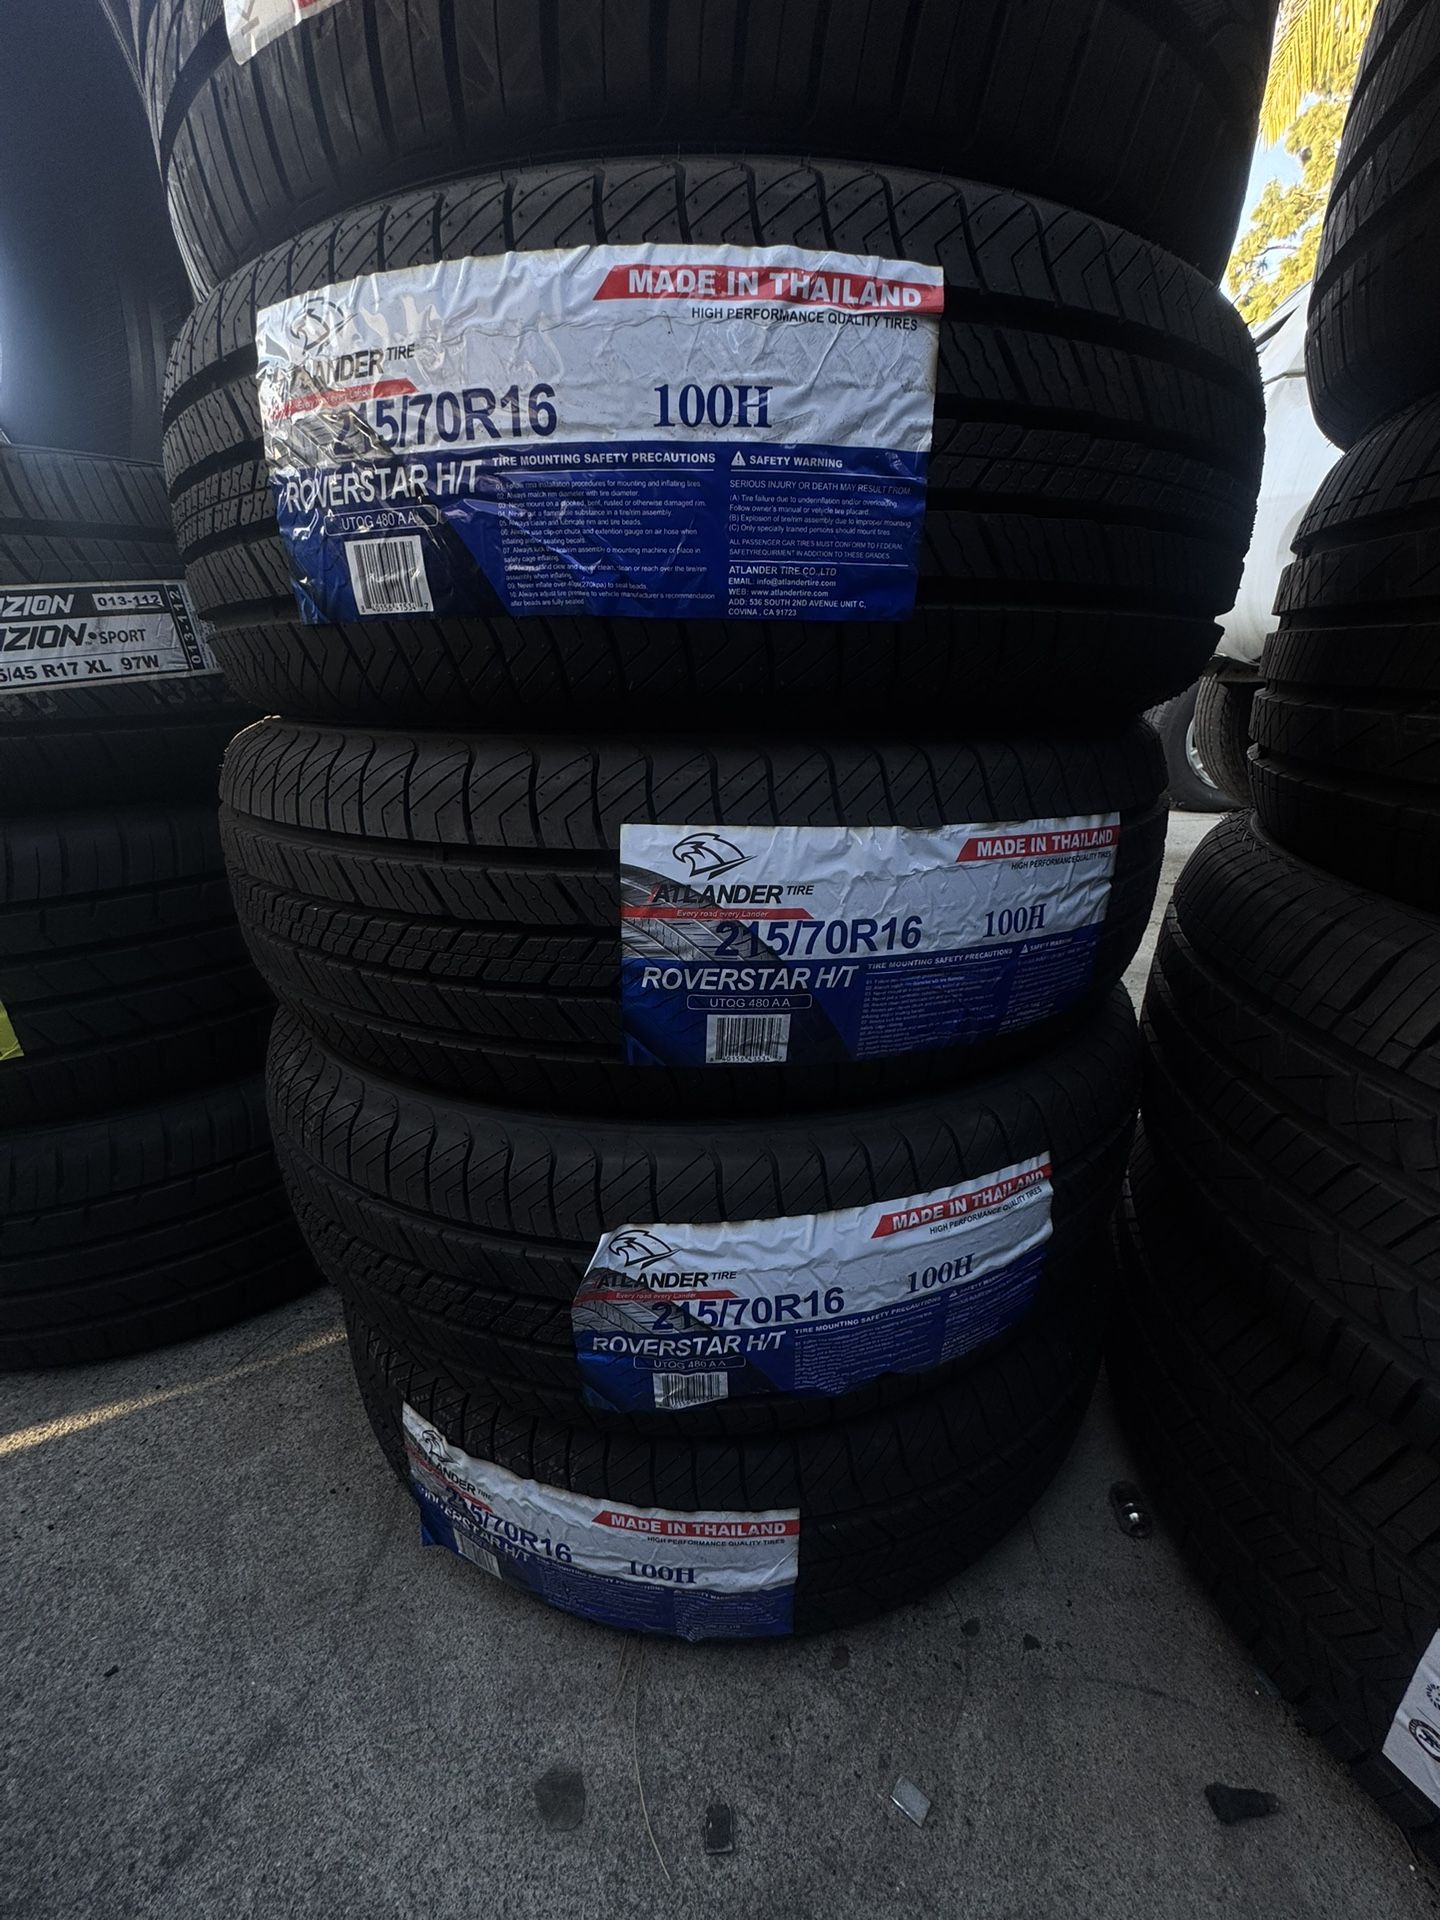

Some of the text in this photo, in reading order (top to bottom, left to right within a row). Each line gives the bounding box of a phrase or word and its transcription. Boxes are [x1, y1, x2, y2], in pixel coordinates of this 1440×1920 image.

[628, 269, 922, 308] MADE IN THAILAND
[691, 307, 918, 331] HIGH PERFORMANCE QUALITY TIRES
[387, 343, 416, 361] TIRE
[653, 383, 773, 429] 100H
[492, 452, 716, 467] TIRE MOUNTING SAFETY PRECAUTIONS
[750, 455, 843, 469] SAFETY WARNING
[286, 459, 483, 513] ROVERSTAR H/T
[729, 480, 887, 494] SERIOUS INJURY OR DEATH MAY RESULT
[376, 511, 396, 526] 480
[740, 524, 756, 533] Only
[742, 538, 781, 546] PASSENGER
[728, 565, 801, 575] ATLANDER TIRE
[0, 593, 160, 617] ZION 013-112
[728, 607, 798, 617] COVINA CA 91723
[763, 599, 791, 607] SOUTH
[791, 599, 808, 607] 2ND
[808, 599, 839, 608] AVENUE
[840, 600, 858, 608] UNIT
[0, 623, 146, 651] ZION SPORT
[170, 590, 202, 665] 013-112
[41, 662, 79, 678] R17
[86, 660, 112, 674] XL
[121, 655, 159, 671] 97W
[976, 829, 1113, 857] MADE IN THAILAND
[1011, 859, 1029, 870] HIGH
[1029, 856, 1072, 868] PERFORMANCE
[1072, 852, 1097, 863] QUALITY
[648, 884, 815, 904] ATLANDER TIRE
[676, 909, 769, 918] Every road every Lander
[714, 903, 1047, 957] 215/70R16 100H
[888, 958, 933, 969] MOUNTING
[934, 954, 963, 965] SAFETY
[964, 948, 1013, 961] PRECAUTIONS
[641, 964, 860, 991] ROVERSTAR H/T
[748, 998, 770, 1008] 480
[892, 1170, 1045, 1230] MADE IN THAILAND
[929, 1186, 1042, 1235] HIGH PERFORMANCE QUALITY TIRES
[593, 1271, 737, 1288] ATLANDER TIRE
[651, 1253, 976, 1331] 215/70R16 100H
[793, 1296, 942, 1334] TIRE MOUNTING SAFETY PRECAUTIONS
[592, 1331, 786, 1356] ROVERSTAR H/T
[418, 1484, 501, 1549] ERSTAR
[504, 1543, 531, 1562] H/T
[610, 1514, 787, 1537] MADE IN THAILAND
[647, 1536, 666, 1544] HIGH
[667, 1538, 726, 1547] PERFORMANCE
[728, 1539, 760, 1547] QUALITY
[628, 1560, 698, 1585] 100H
